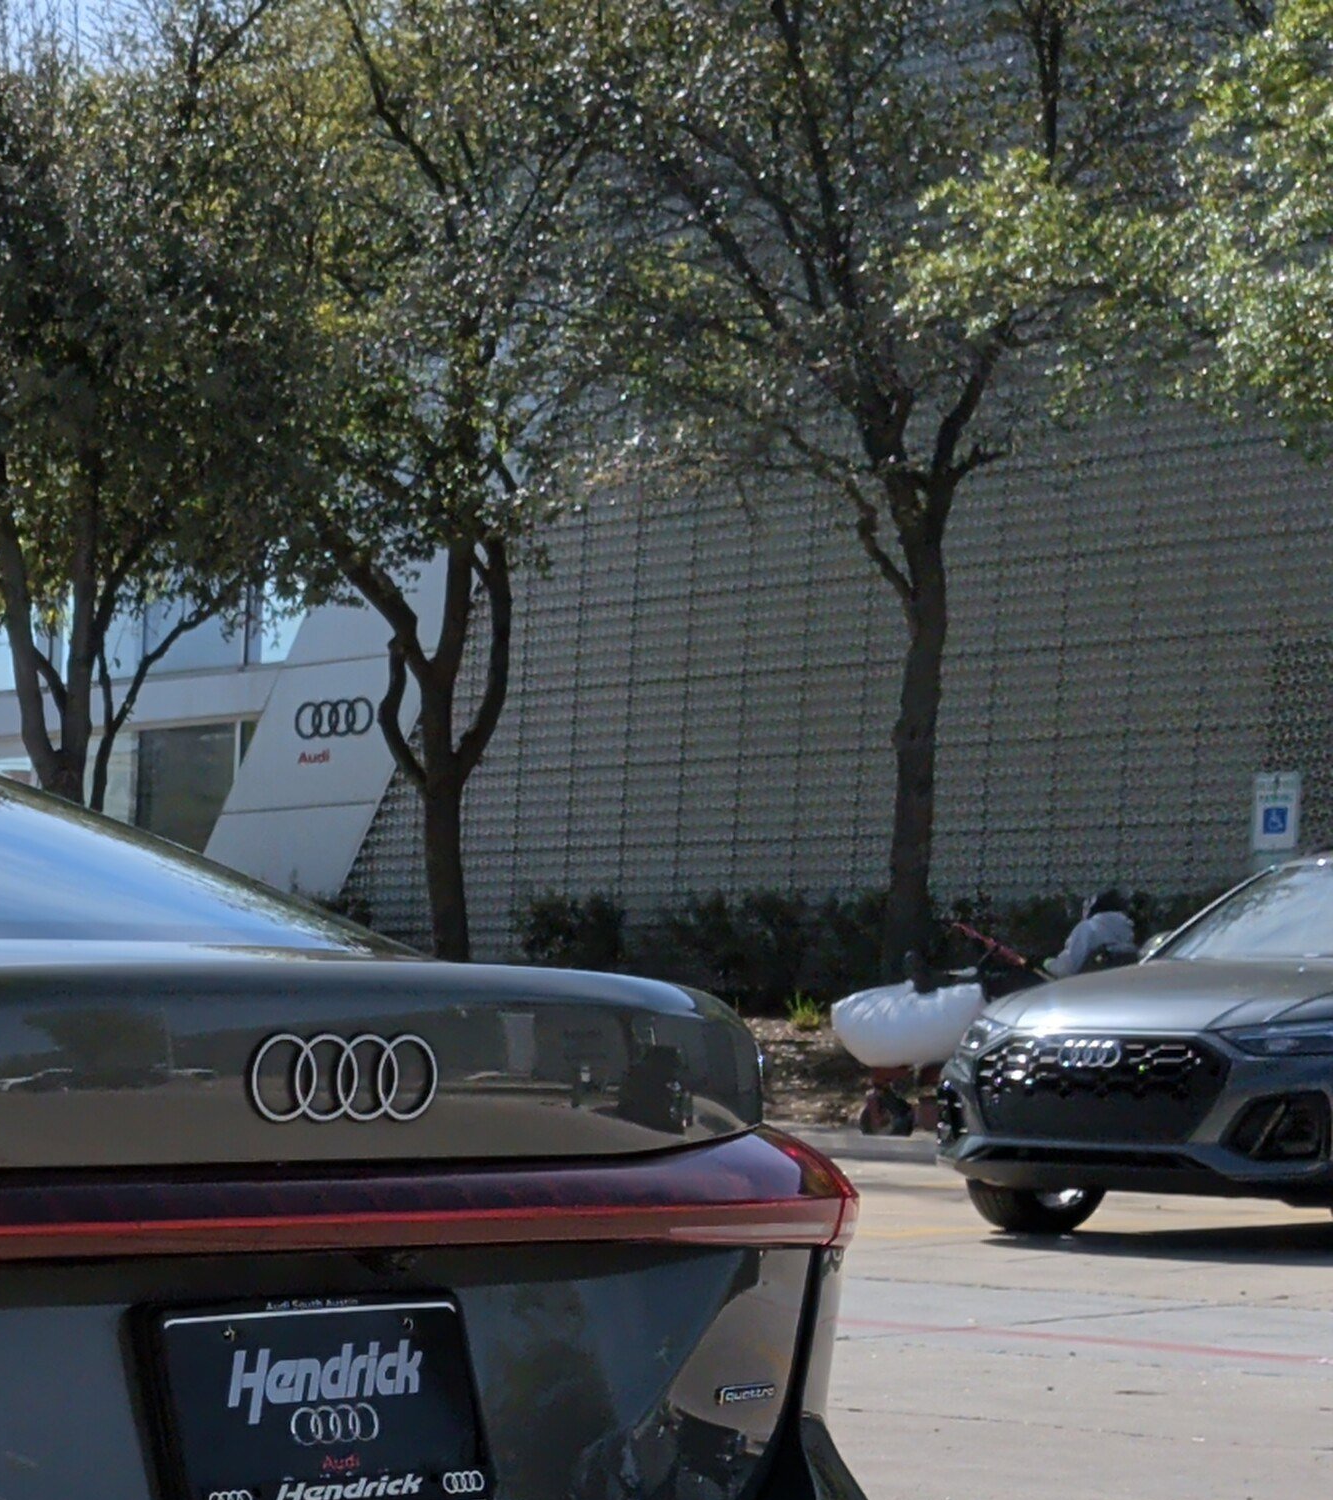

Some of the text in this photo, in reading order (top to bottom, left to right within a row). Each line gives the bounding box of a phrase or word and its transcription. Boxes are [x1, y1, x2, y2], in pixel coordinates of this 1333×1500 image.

[297, 748, 330, 765] Audi
[266, 1298, 359, 1311] Audi South Austin
[228, 1339, 423, 1425] Hendrick
[322, 1454, 361, 1471] Audi
